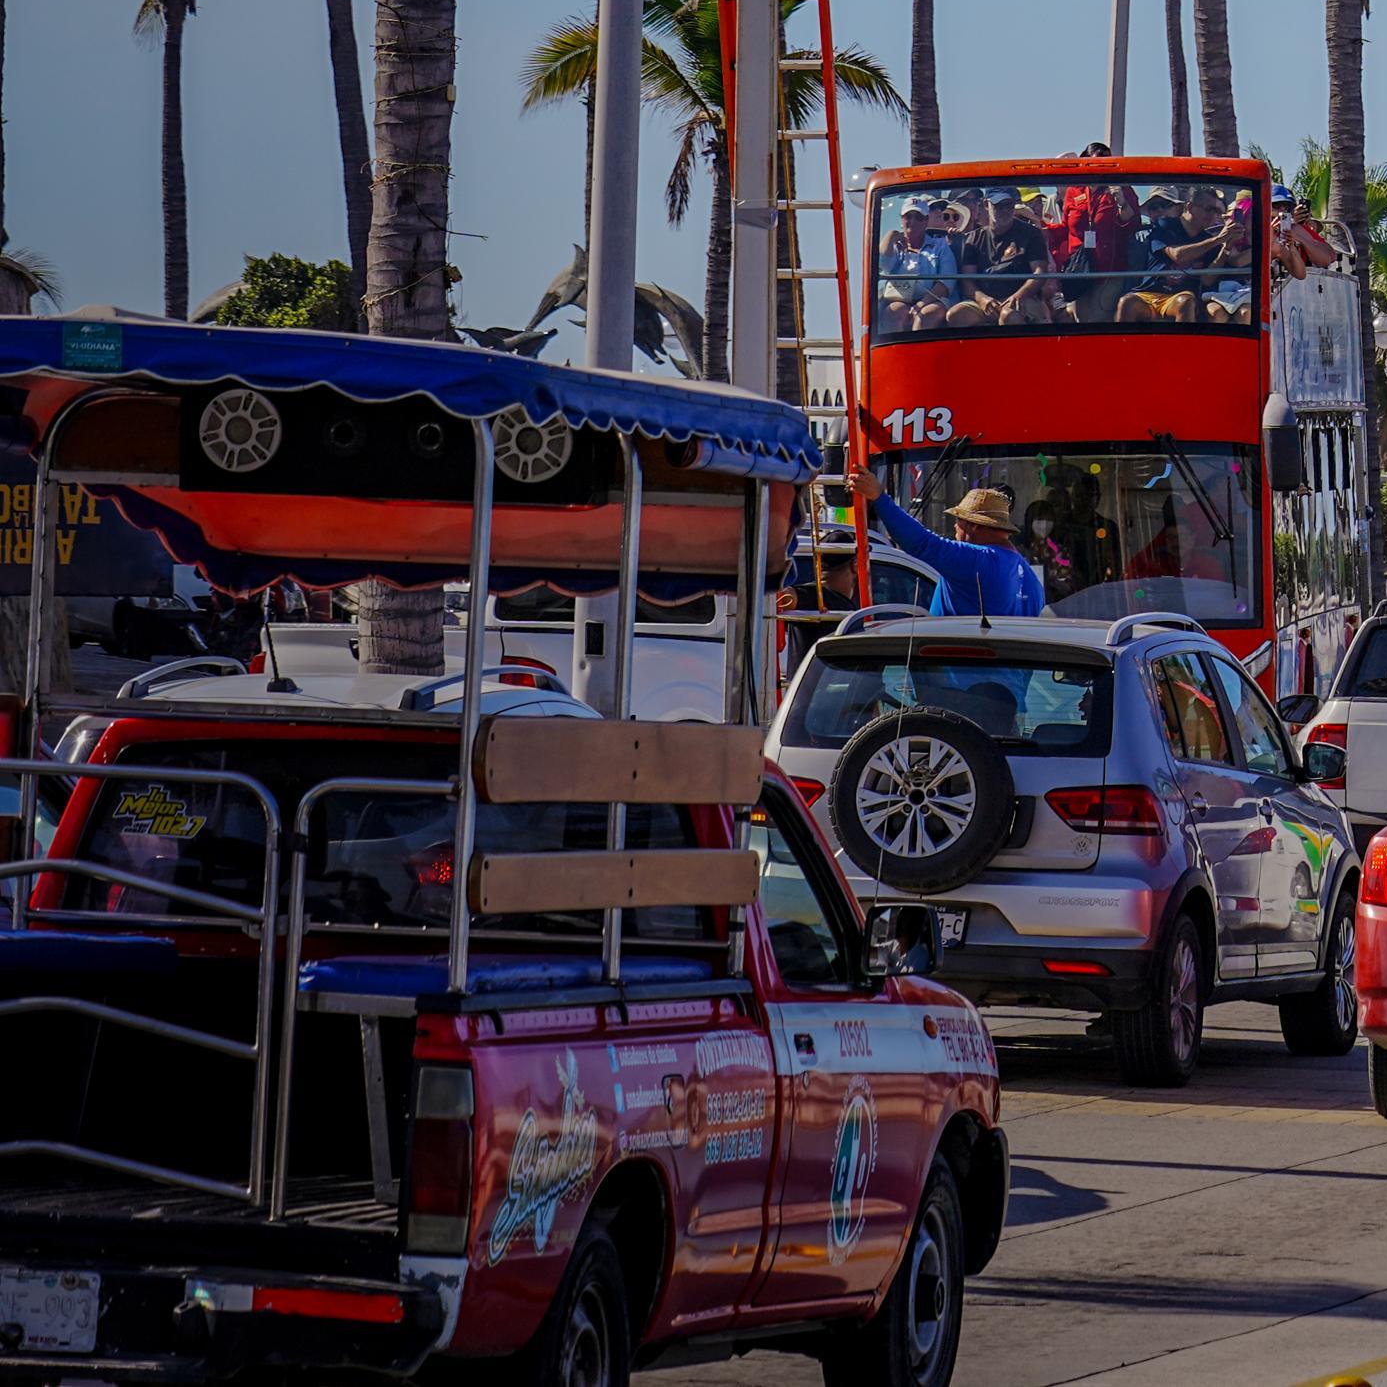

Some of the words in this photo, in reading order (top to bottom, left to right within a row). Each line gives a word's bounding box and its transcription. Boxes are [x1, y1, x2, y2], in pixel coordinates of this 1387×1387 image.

[882, 406, 954, 444] 113
[118, 795, 184, 820] Mejor
[150, 815, 205, 836] 102.7
